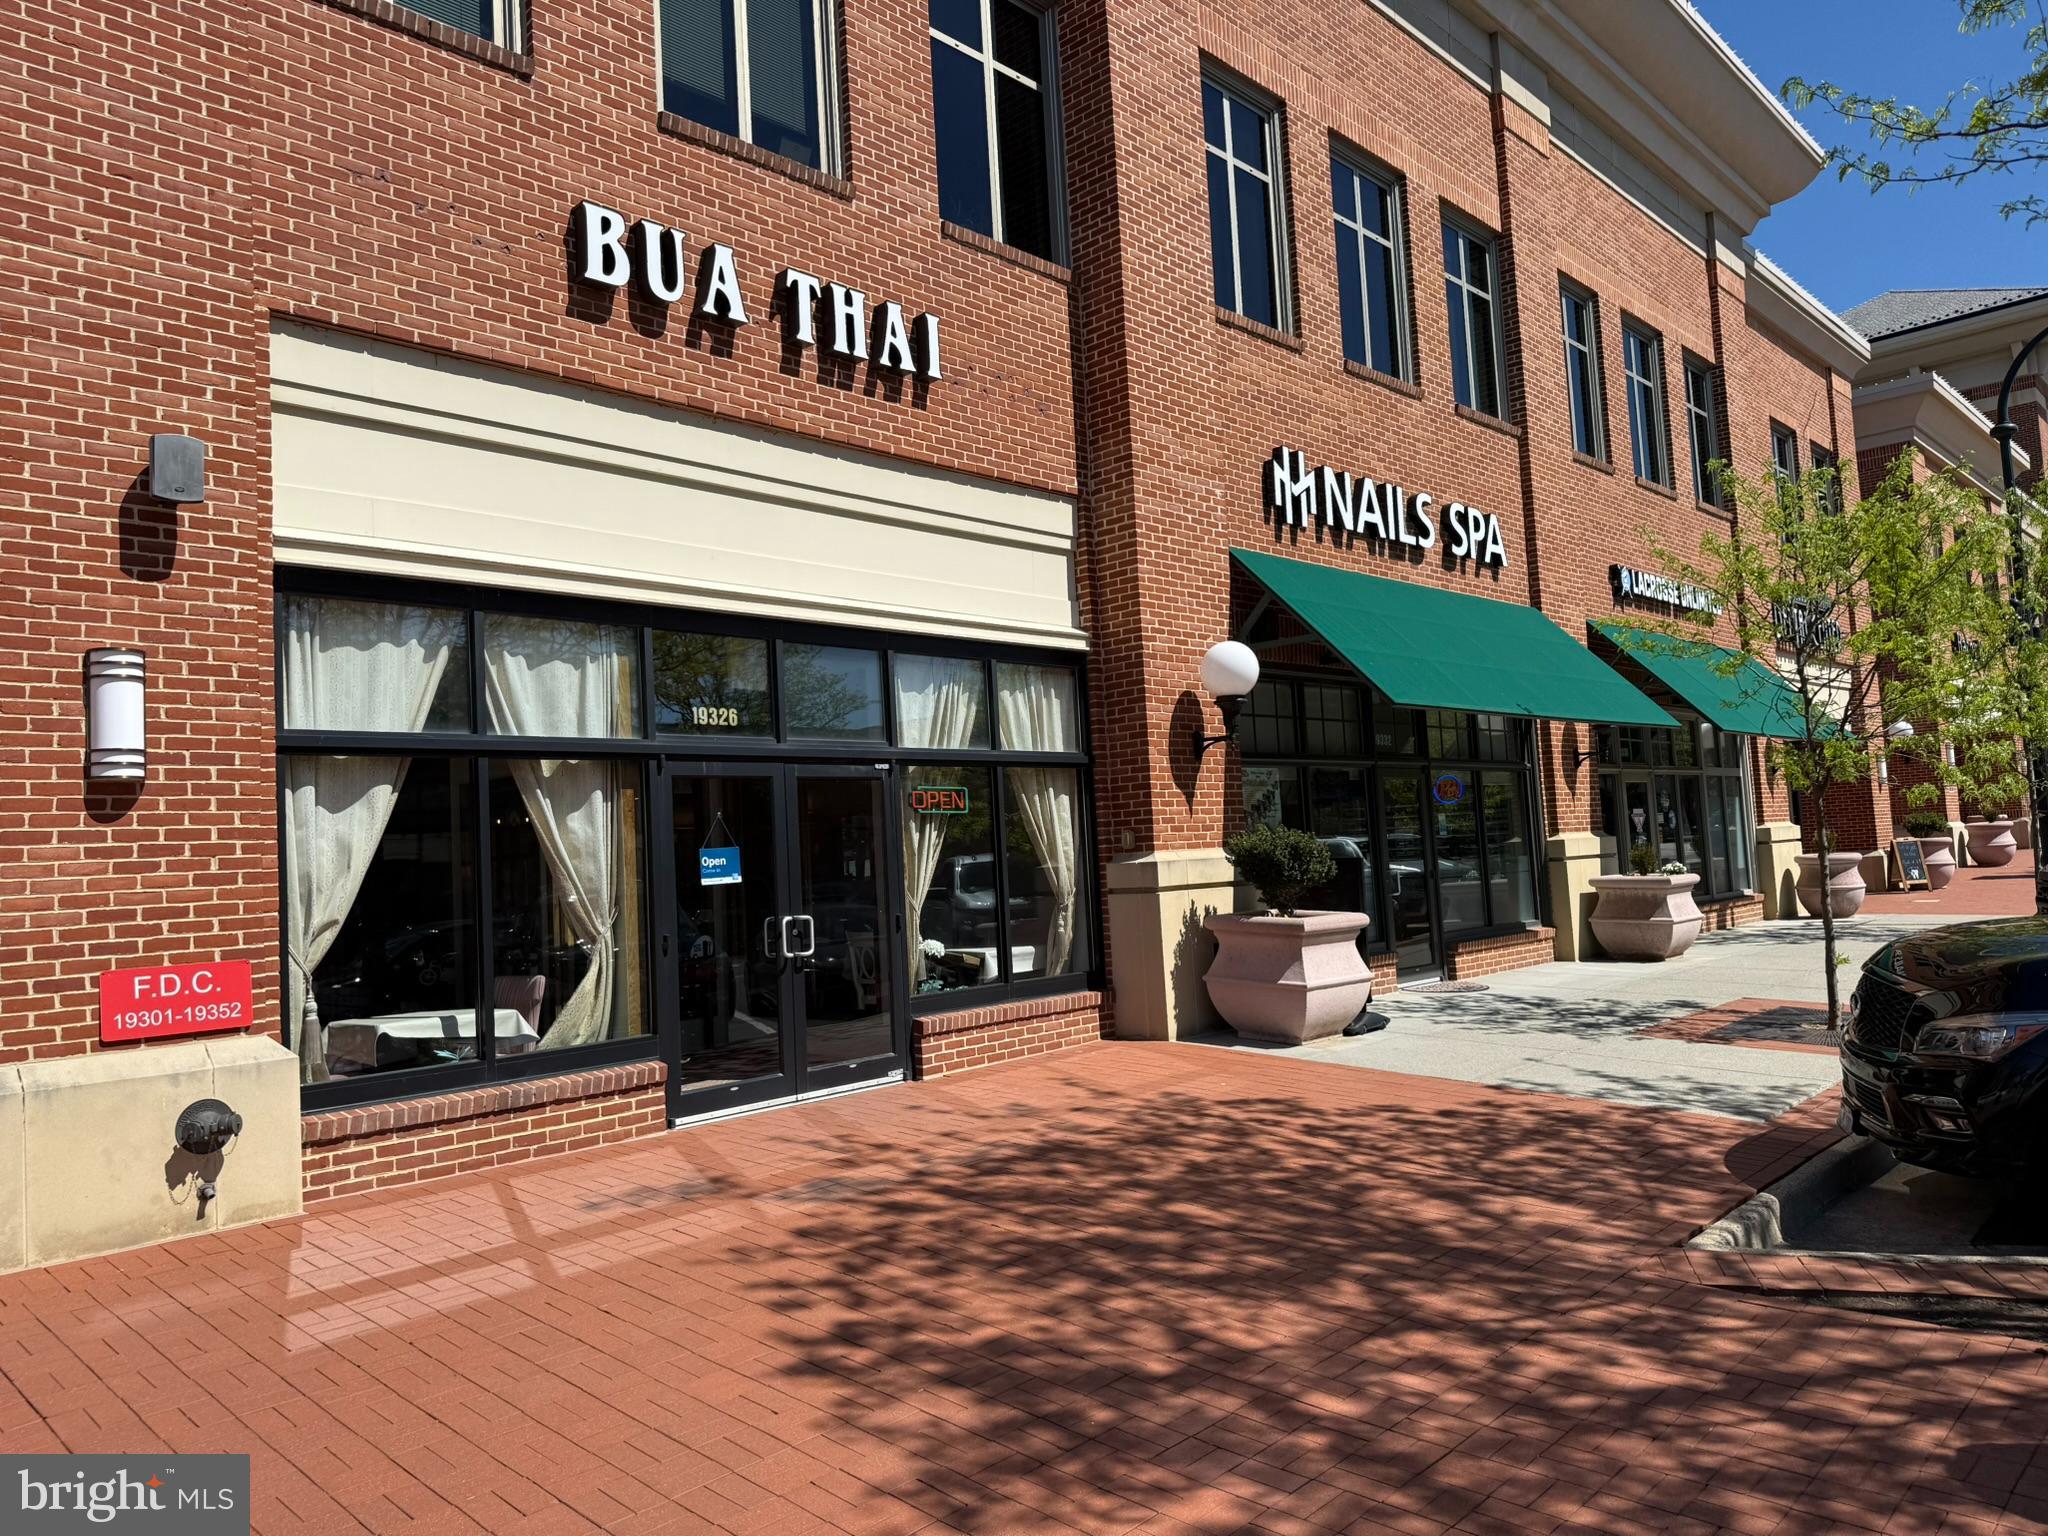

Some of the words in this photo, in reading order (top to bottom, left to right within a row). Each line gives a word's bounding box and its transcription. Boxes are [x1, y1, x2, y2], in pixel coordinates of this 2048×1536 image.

[577, 201, 749, 324] BUA
[778, 268, 942, 381] THAI
[1321, 466, 1435, 549] NAILS
[1447, 503, 1509, 567] SPA
[1632, 570, 1680, 605] LACROSSE
[692, 707, 738, 727] 19326
[911, 790, 965, 809] OPEN
[702, 856, 726, 868] Open
[132, 971, 222, 999] F.D.C.
[113, 1002, 242, 1030] 19301-19352
